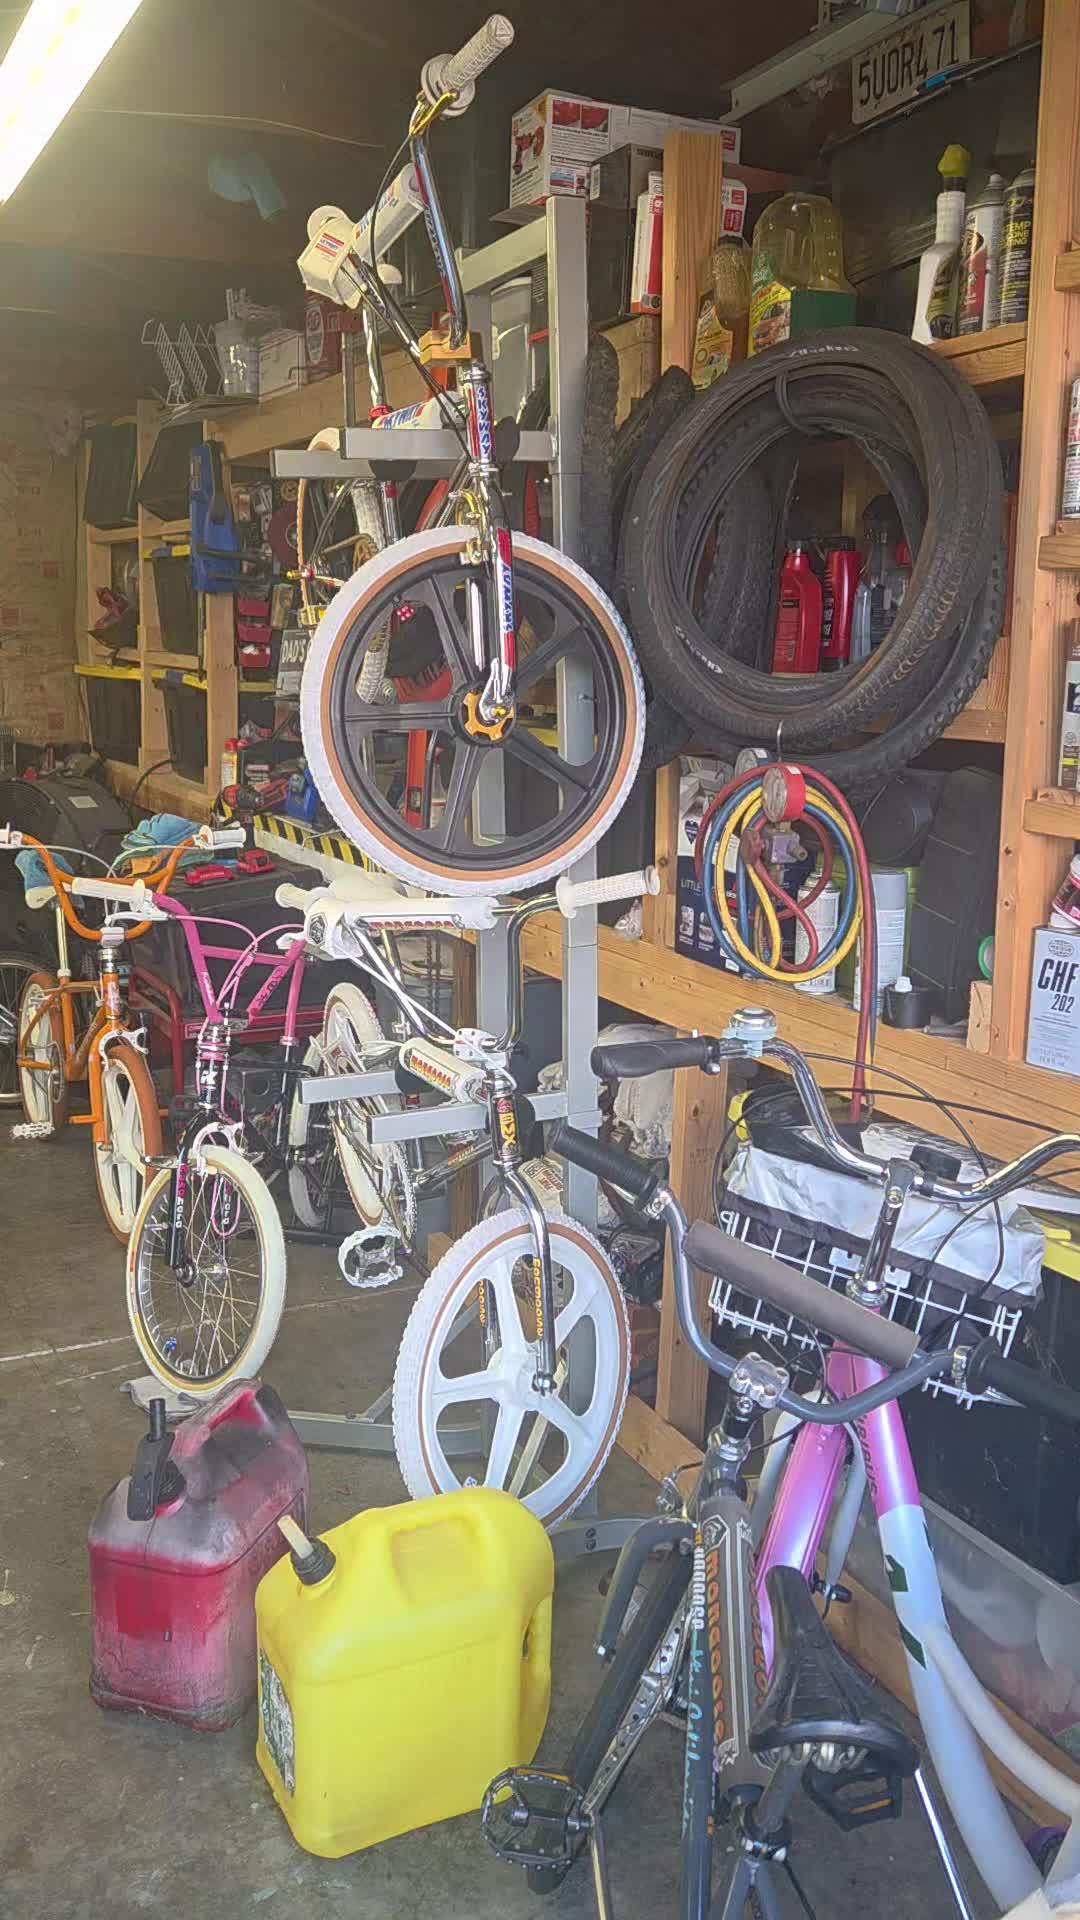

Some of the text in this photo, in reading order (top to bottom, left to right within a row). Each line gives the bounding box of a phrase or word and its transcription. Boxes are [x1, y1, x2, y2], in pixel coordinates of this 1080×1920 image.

[477, 386, 492, 455] SKYWAY
[1037, 957, 1079, 994] CHF
[1050, 993, 1075, 1014] 202
[498, 1112, 517, 1146] BMX
